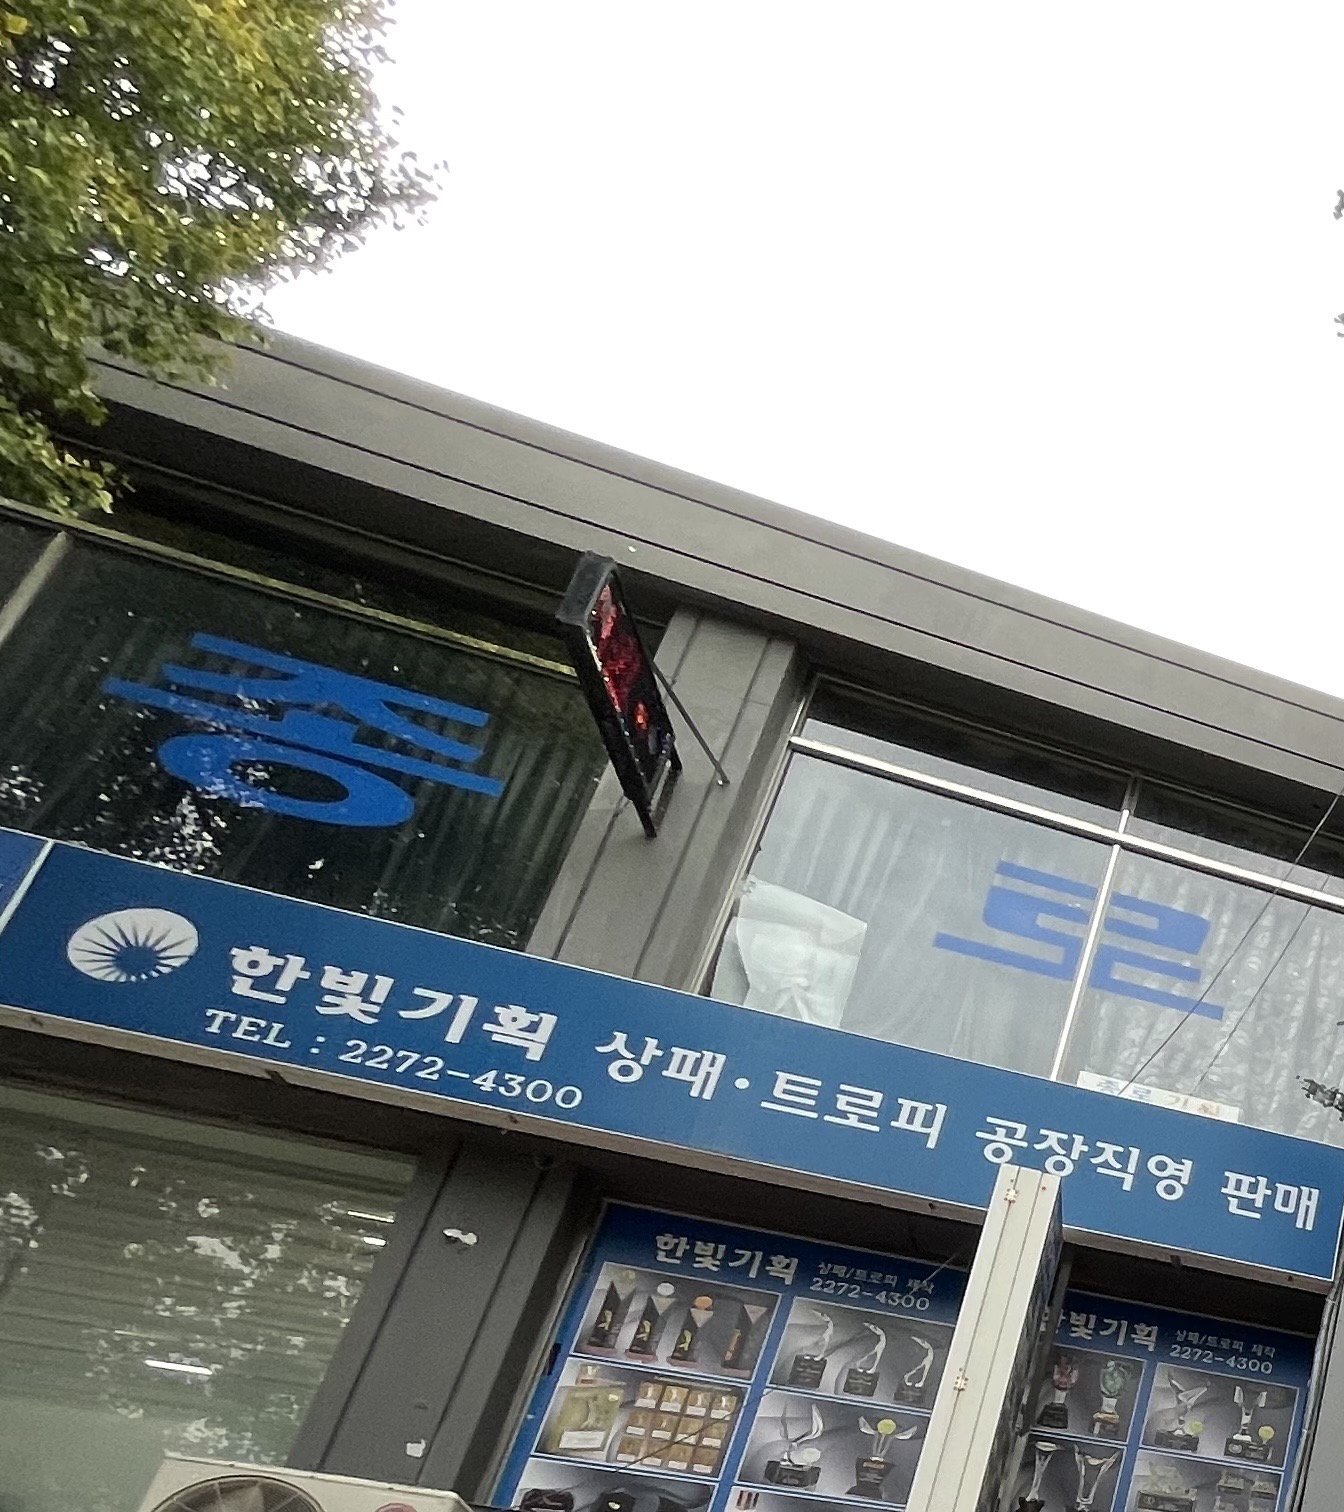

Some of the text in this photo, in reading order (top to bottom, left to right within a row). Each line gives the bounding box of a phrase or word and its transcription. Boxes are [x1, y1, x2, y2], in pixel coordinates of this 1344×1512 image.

[101, 631, 504, 827] 종
[933, 860, 1223, 1020] 로
[205, 1007, 584, 1111] TEL 2272-4300
[228, 945, 1321, 1234] 한빛기획 상패·트로피 공장직영 판매
[655, 1233, 799, 1285] 한빛기획
[809, 1277, 931, 1311] 2272-4300
[1169, 1344, 1274, 1374] 2272-4300
